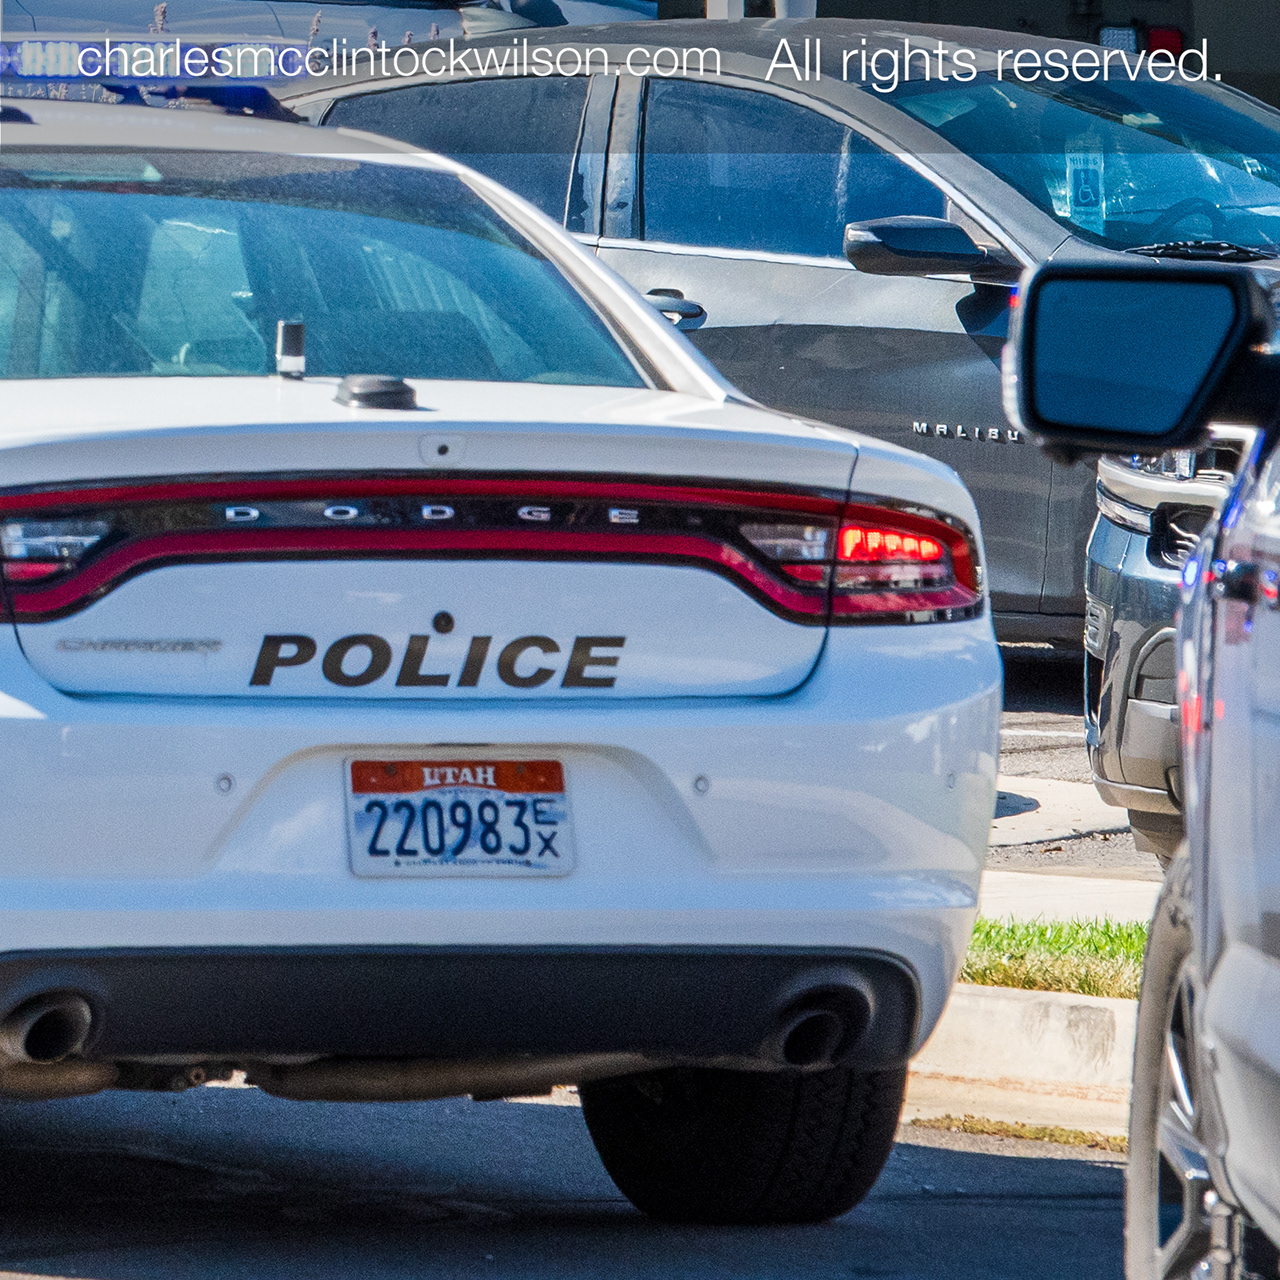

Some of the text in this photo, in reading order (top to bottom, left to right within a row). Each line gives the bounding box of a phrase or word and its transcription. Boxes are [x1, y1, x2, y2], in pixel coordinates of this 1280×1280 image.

[912, 421, 1020, 441] MALIBU
[225, 505, 640, 524] DODGE
[249, 633, 627, 690] POLICE
[422, 766, 497, 787] UTAH
[364, 798, 532, 857] 220983
